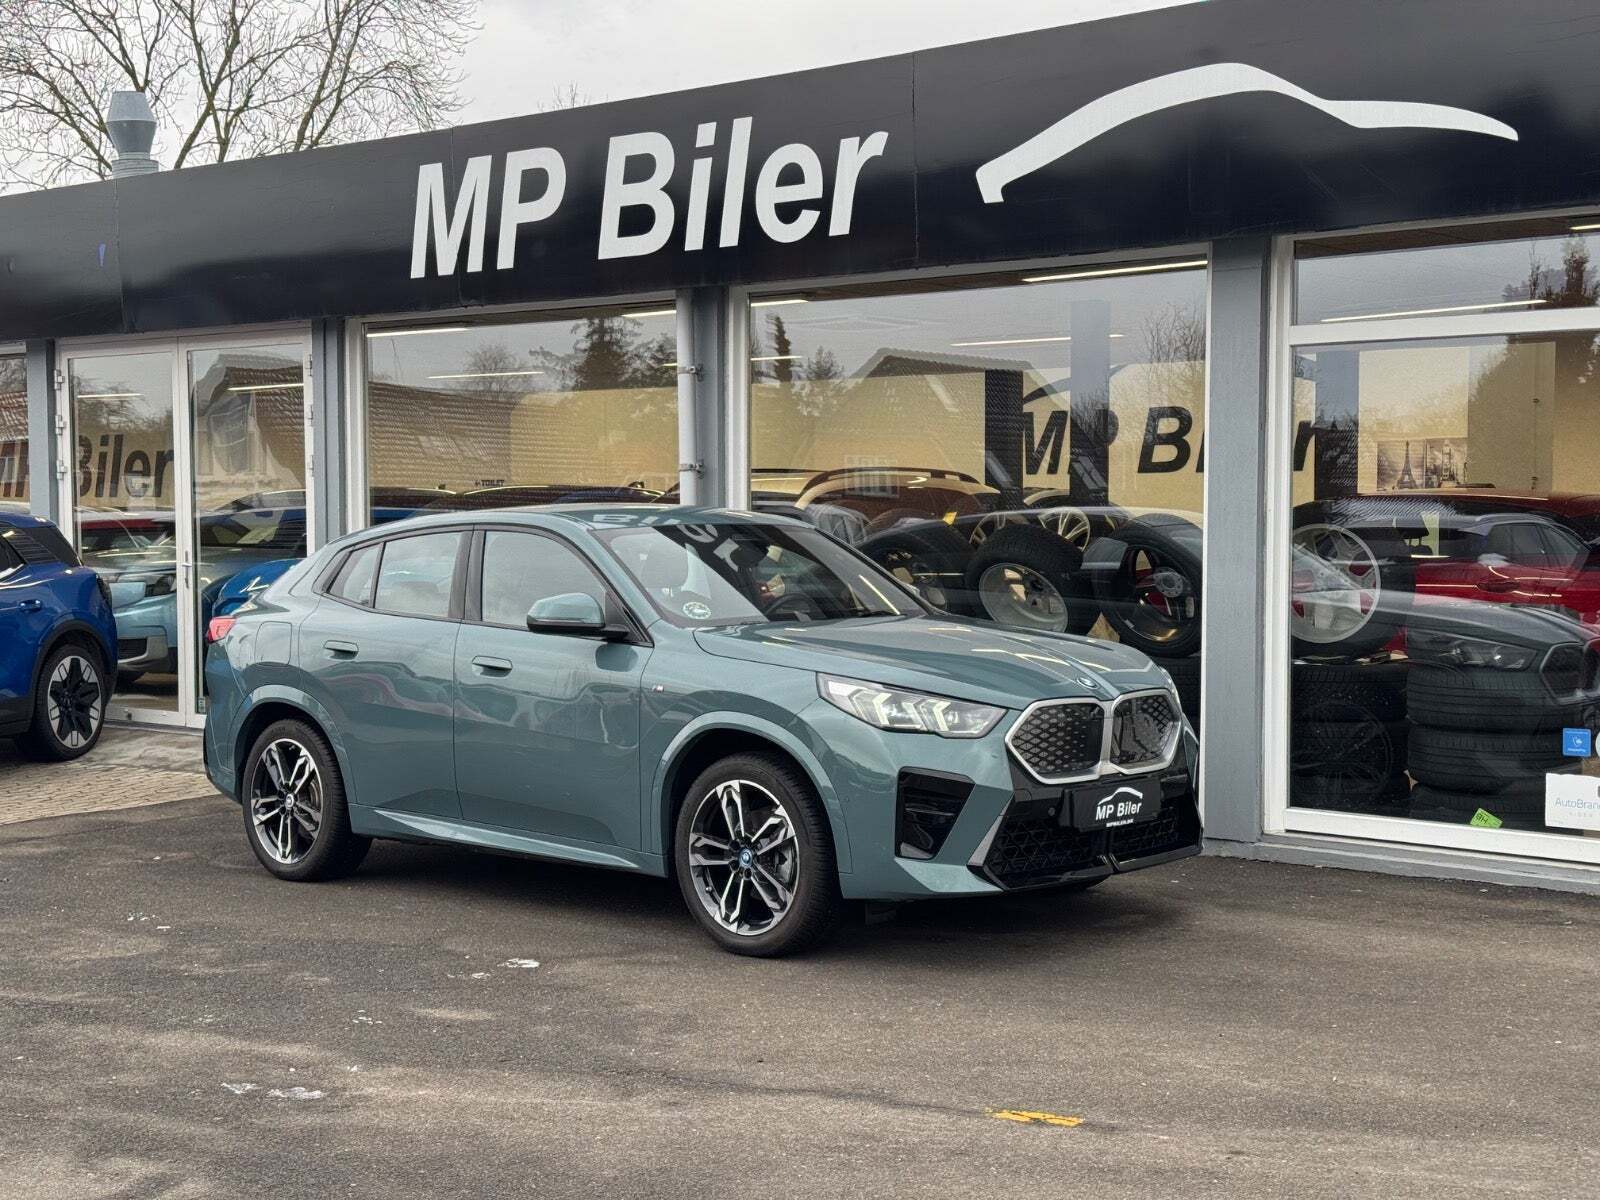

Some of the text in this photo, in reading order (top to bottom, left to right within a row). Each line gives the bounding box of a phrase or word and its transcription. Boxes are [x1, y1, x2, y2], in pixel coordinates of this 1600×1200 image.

[410, 116, 889, 279] MP Biler
[1095, 800, 1142, 821] MP Biler
